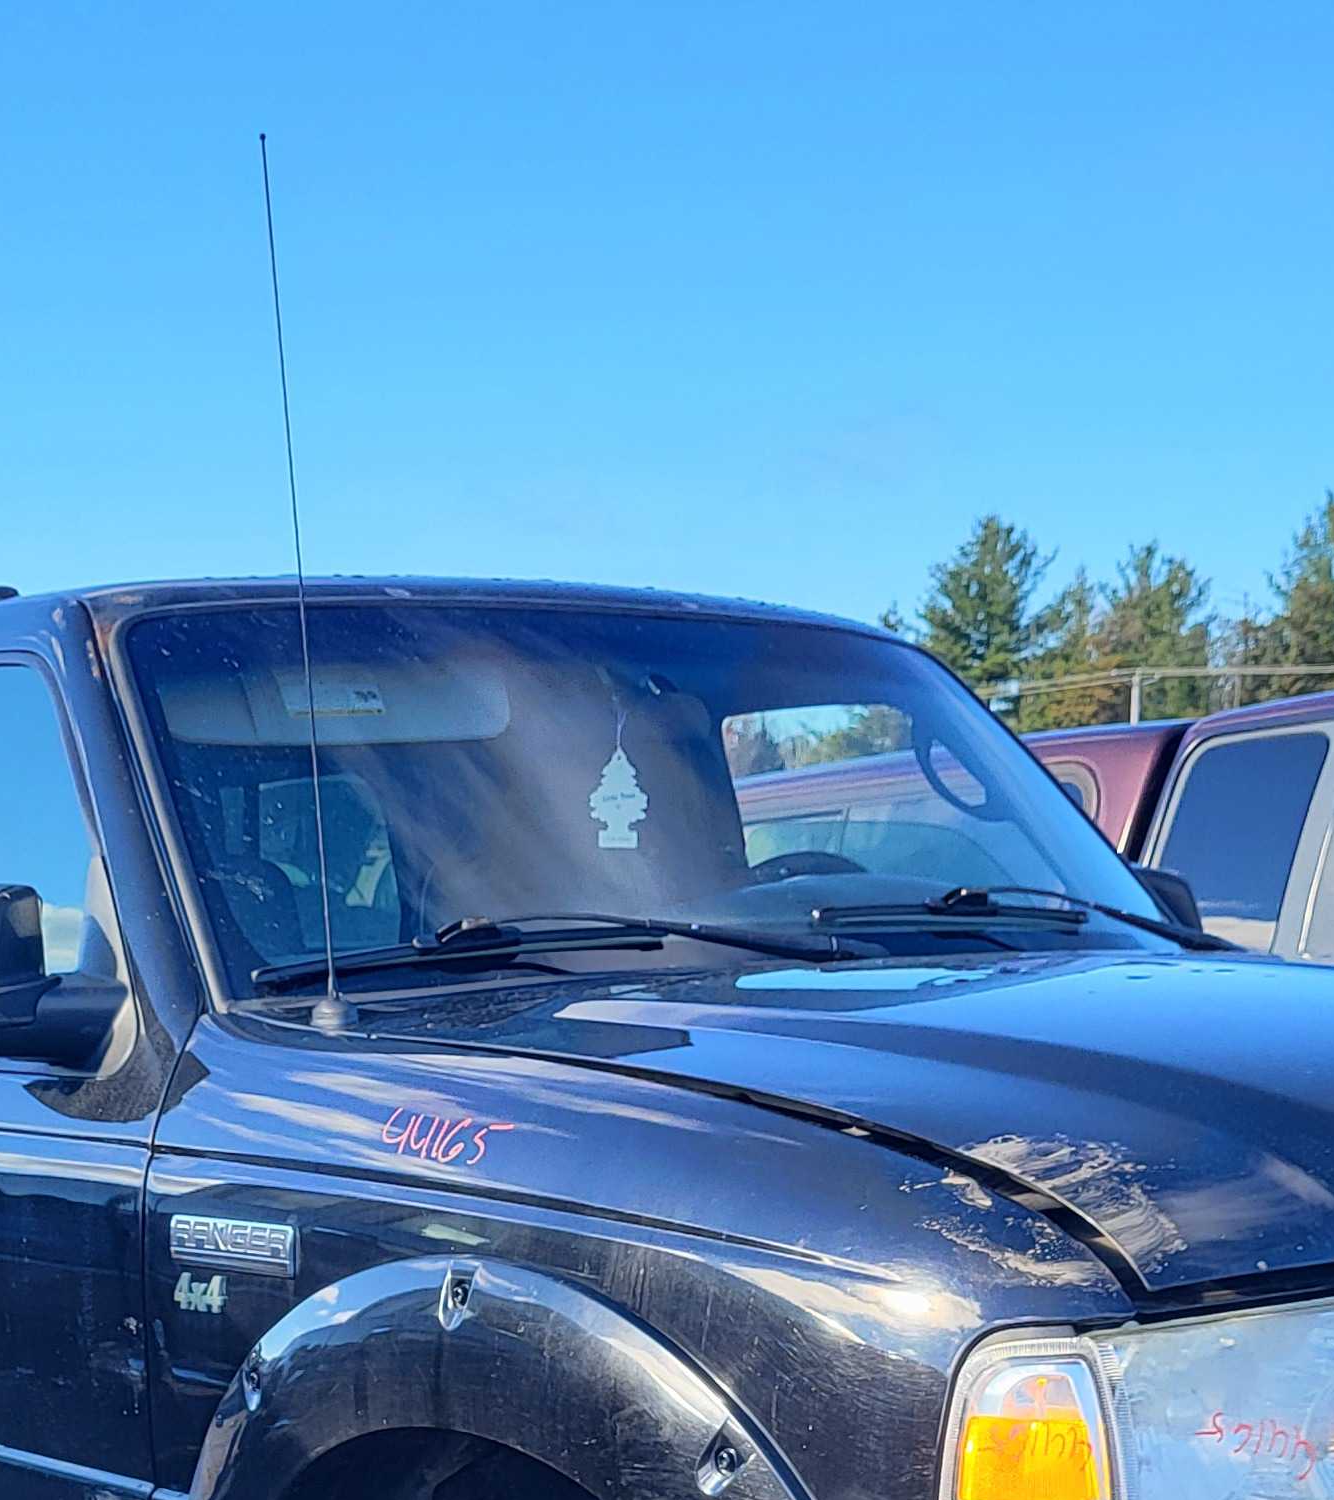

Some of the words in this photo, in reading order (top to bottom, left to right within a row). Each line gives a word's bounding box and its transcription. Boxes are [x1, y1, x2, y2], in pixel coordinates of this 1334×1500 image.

[381, 1107, 515, 1165] 44165
[173, 1218, 288, 1258] RANGER
[173, 1272, 228, 1314] 4x4
[1195, 1411, 1316, 1481] 44165
